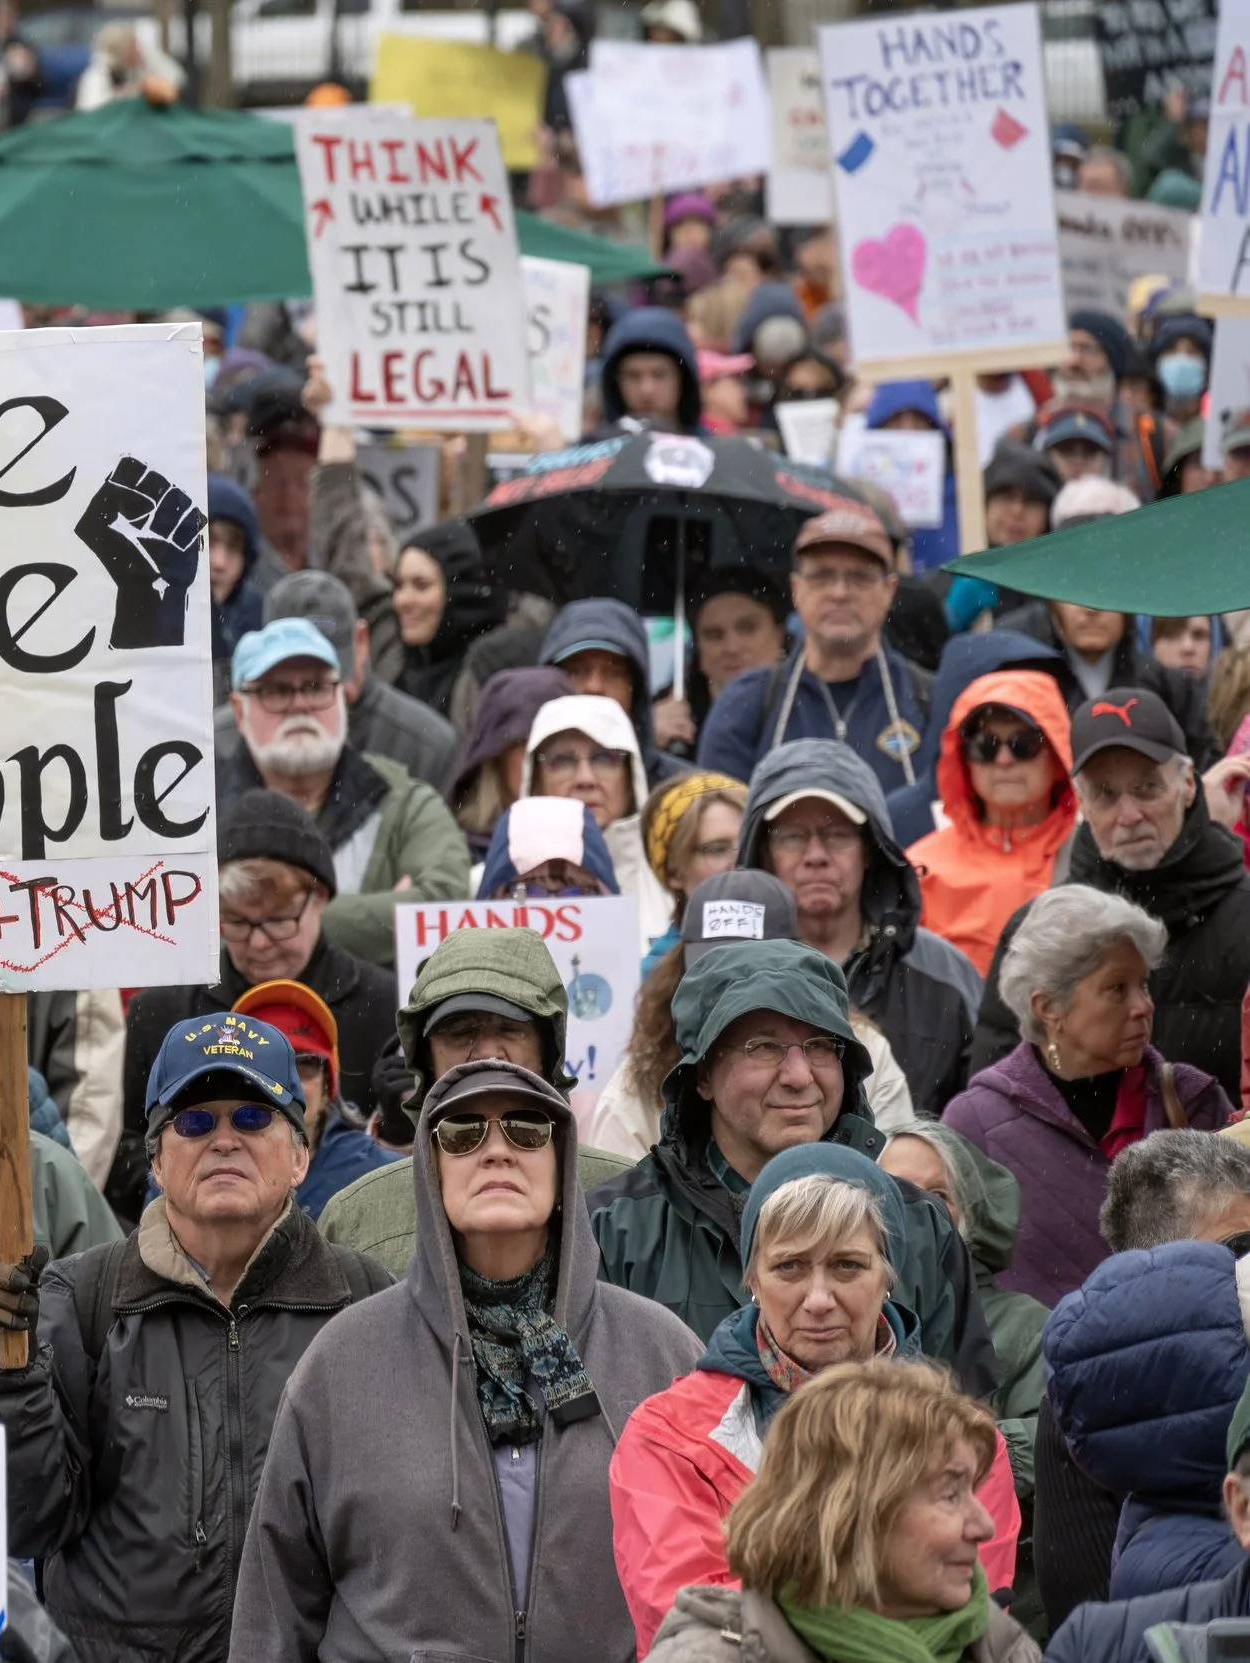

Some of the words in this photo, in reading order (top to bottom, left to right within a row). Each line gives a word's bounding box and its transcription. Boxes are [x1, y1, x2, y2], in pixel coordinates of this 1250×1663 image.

[877, 18, 1005, 70] HANDS
[831, 60, 1026, 120] TOGETHER
[310, 134, 485, 184] THINK
[350, 191, 473, 227] WHILE
[340, 243, 404, 293] IT
[420, 239, 491, 288] IS
[370, 301, 474, 338] STILL
[350, 350, 511, 404] LEGAL
[185, 1023, 217, 1042] U.S.
[225, 1016, 270, 1045] NAVY
[203, 1044, 254, 1060] VETERAN
[134, 1395, 168, 1405] Columbia
